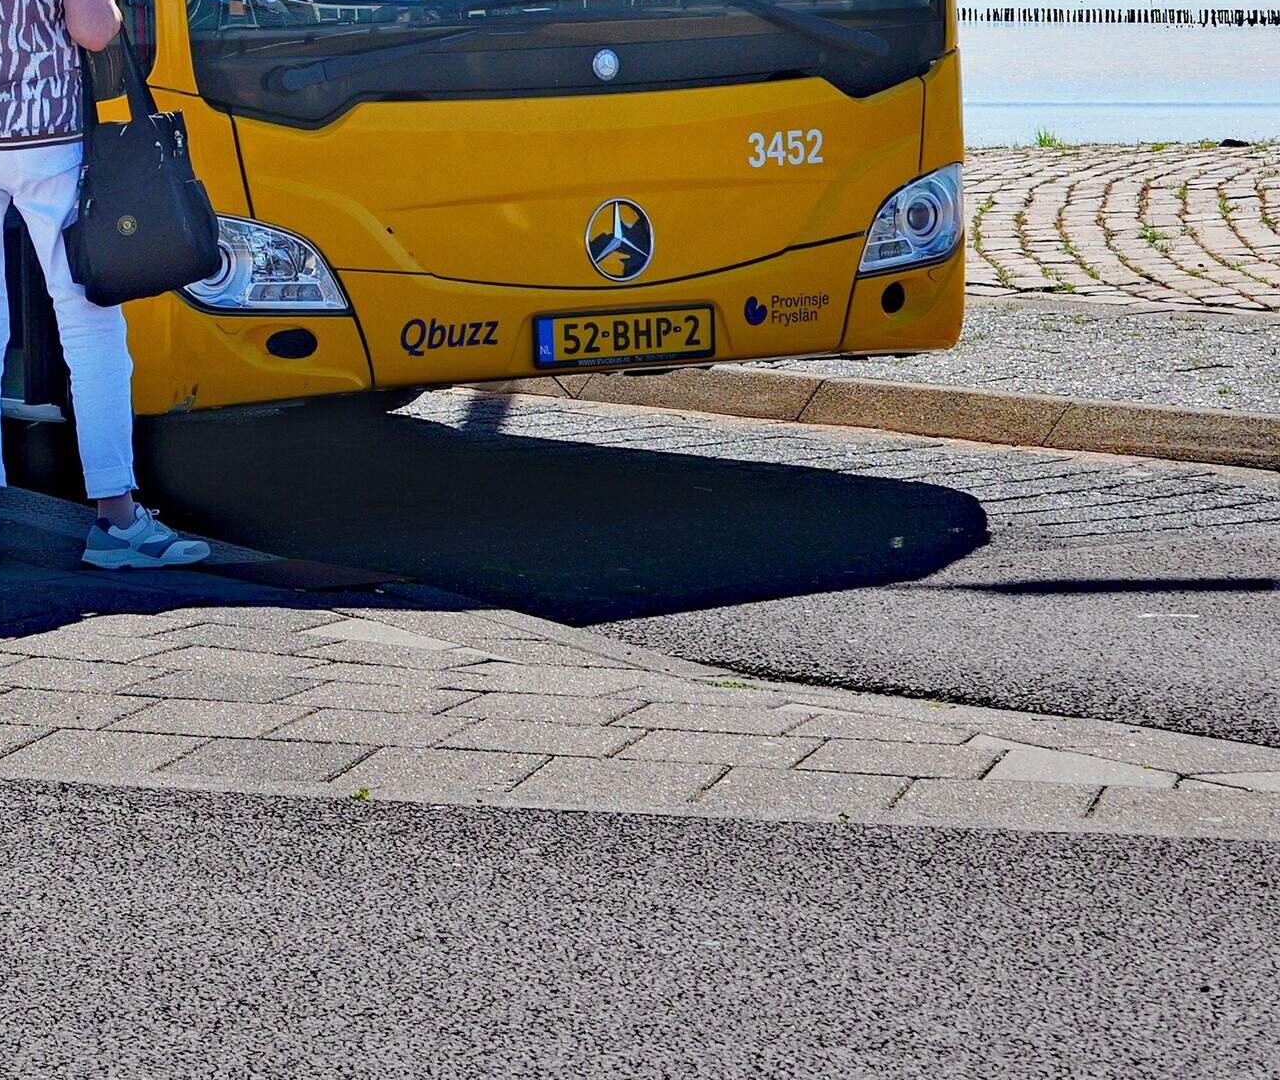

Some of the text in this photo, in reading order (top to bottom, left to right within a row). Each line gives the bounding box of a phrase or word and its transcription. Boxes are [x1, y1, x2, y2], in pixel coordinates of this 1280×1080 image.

[748, 128, 824, 168] 3452
[771, 291, 829, 309] Provinsje
[771, 308, 818, 327] Fryslân
[400, 318, 499, 356] Qbuzz
[564, 315, 701, 355] 52-BHP-2
[540, 346, 552, 356] NL
